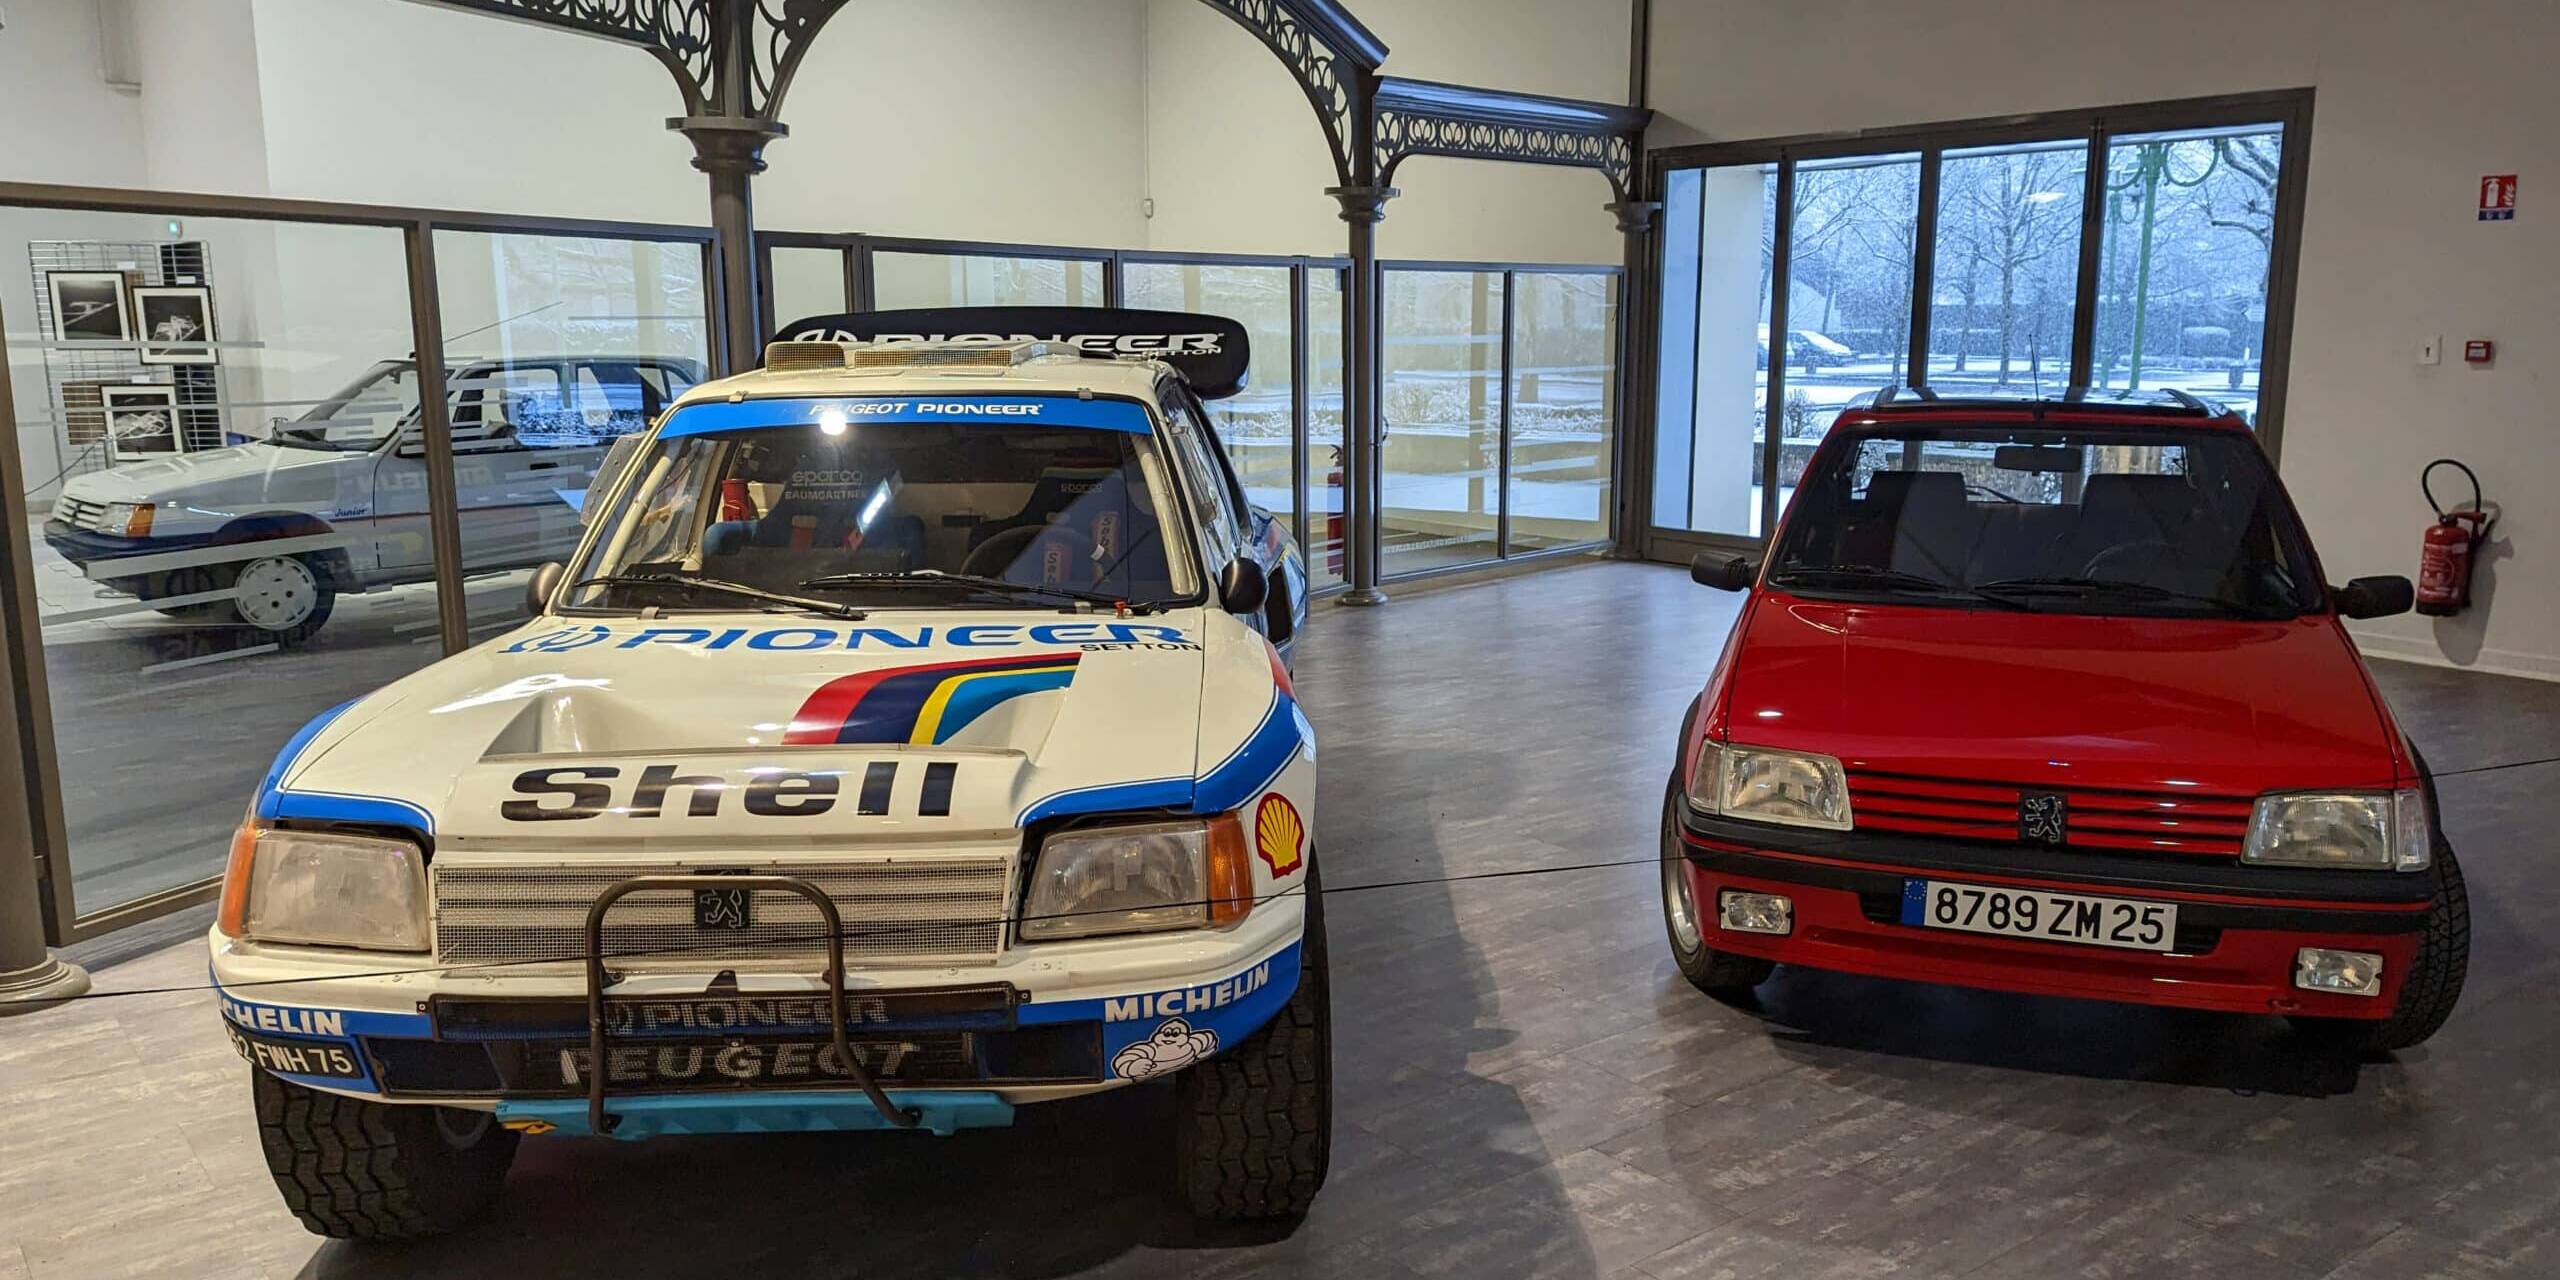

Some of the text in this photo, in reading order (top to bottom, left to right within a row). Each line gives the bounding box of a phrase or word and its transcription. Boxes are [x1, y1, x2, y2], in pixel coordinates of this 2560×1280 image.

[809, 402, 1040, 415] PGEOT PIONEER
[334, 506, 368, 517] Junior
[619, 624, 1193, 651] PIONEER
[1079, 643, 1203, 652] SETTON
[500, 761, 959, 822] Shell
[1935, 887, 2166, 944] 8789 ZM 25
[1104, 960, 1270, 1023] MICHELIN
[219, 996, 344, 1036] CHELIN
[252, 1041, 311, 1073] FWH
[307, 1048, 353, 1074] 75
[560, 1043, 920, 1087] PEUGEOT
